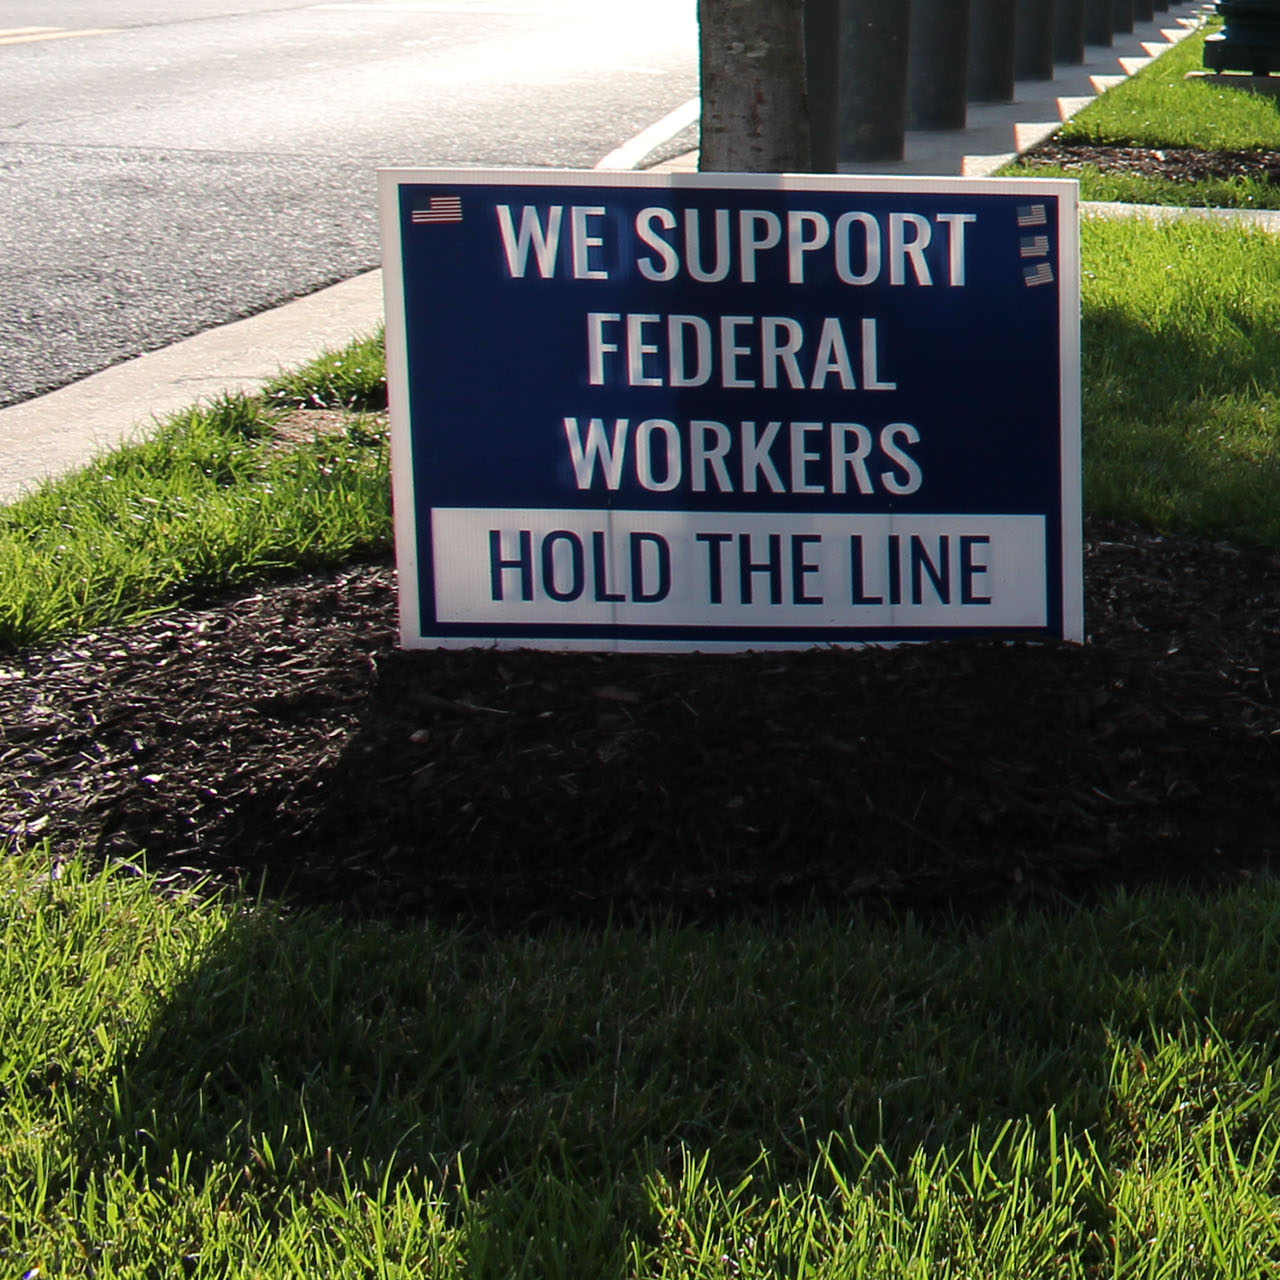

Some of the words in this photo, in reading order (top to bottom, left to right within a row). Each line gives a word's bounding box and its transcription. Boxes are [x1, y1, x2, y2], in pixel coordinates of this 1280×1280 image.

[497, 204, 608, 281] WE
[636, 207, 977, 287] SUPPORT
[587, 313, 897, 391] FEDERAL
[565, 417, 922, 496] WORKERS
[489, 529, 671, 603] HOLD
[697, 533, 823, 605] THE
[851, 535, 992, 606] LINE
